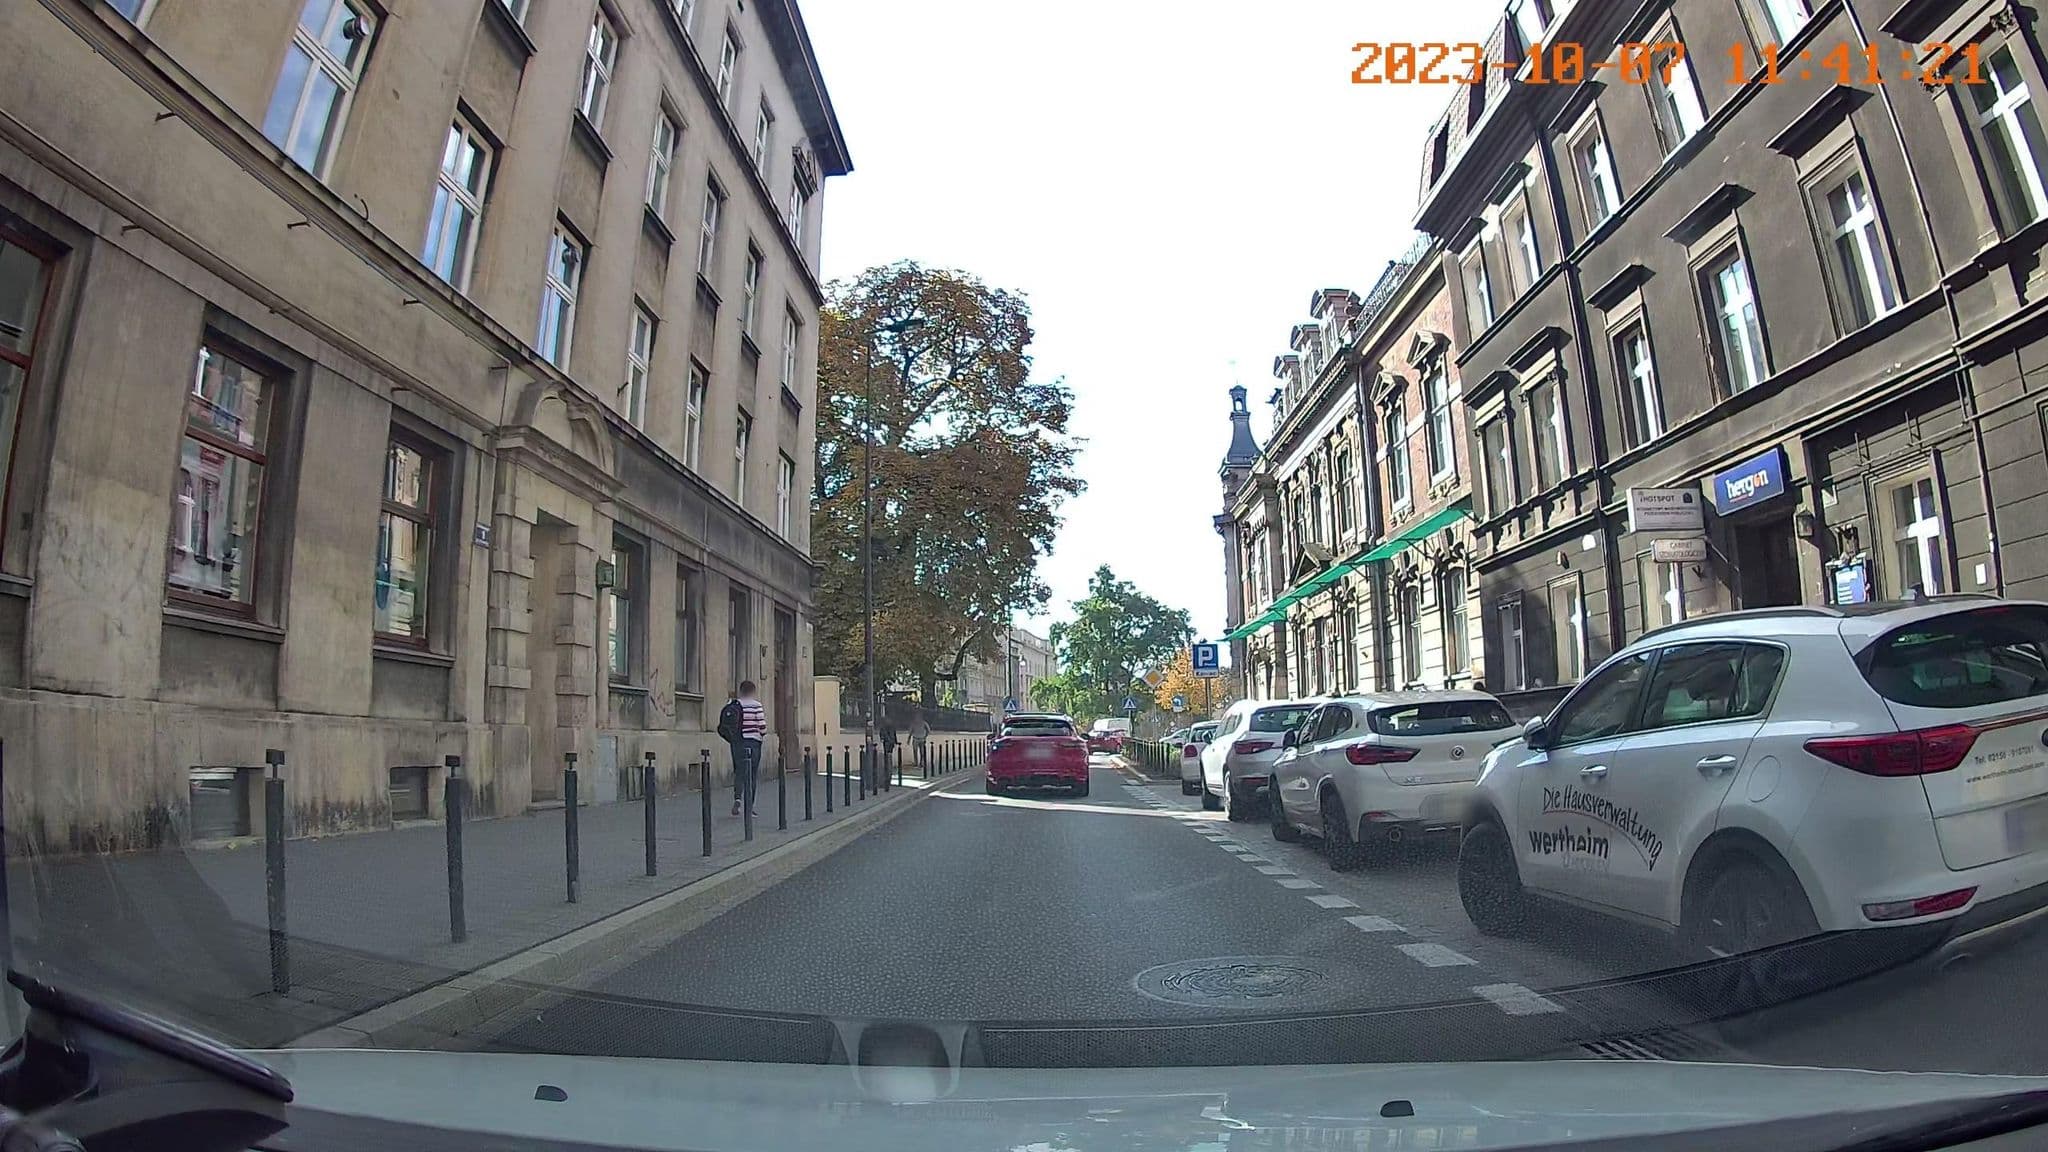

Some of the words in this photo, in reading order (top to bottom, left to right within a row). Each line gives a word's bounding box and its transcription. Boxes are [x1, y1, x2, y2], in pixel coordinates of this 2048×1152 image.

[1198, 646, 1213, 667] P
[1543, 788, 1561, 812] Die
[1563, 785, 1663, 872] Hausverwaltung
